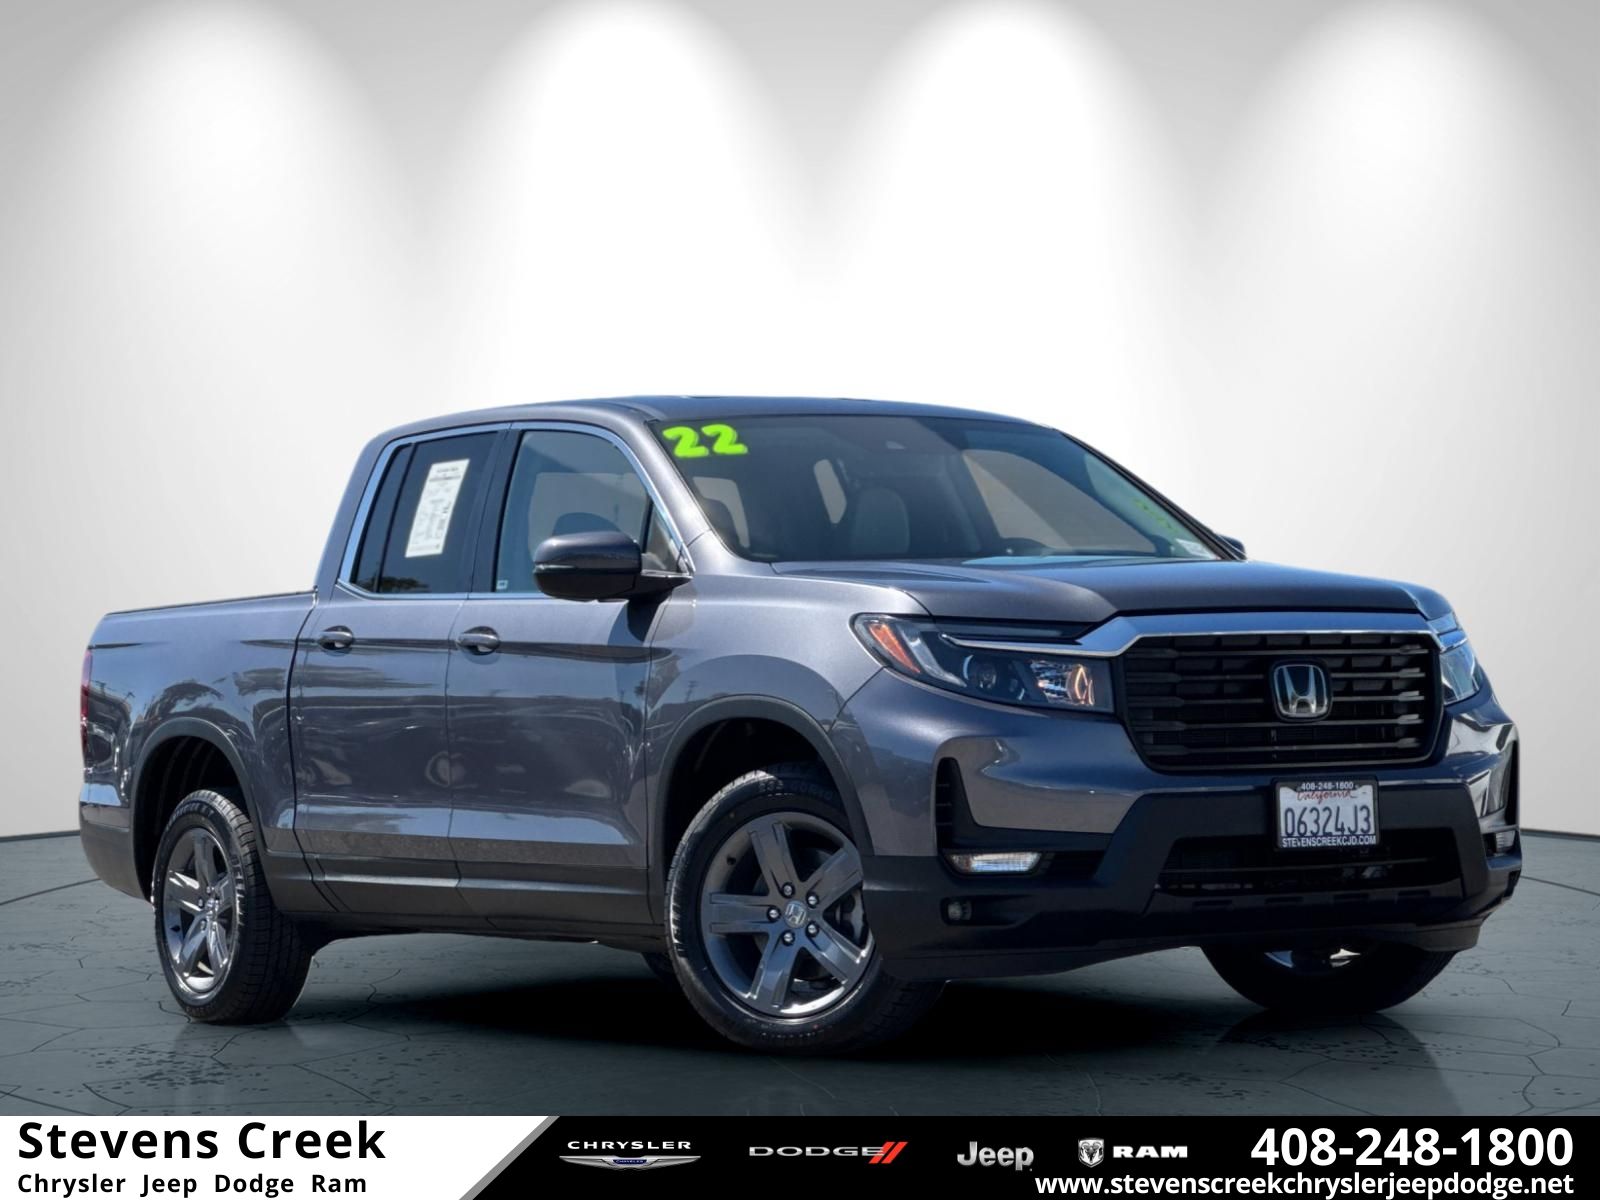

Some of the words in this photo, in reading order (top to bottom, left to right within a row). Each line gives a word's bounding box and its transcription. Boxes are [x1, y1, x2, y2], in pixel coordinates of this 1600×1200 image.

[662, 423, 748, 458] 22
[1301, 781, 1354, 791] 408-248-1800
[1284, 804, 1371, 837] 06324J3
[1281, 835, 1377, 848] STEVENSCREEKCJD.COM
